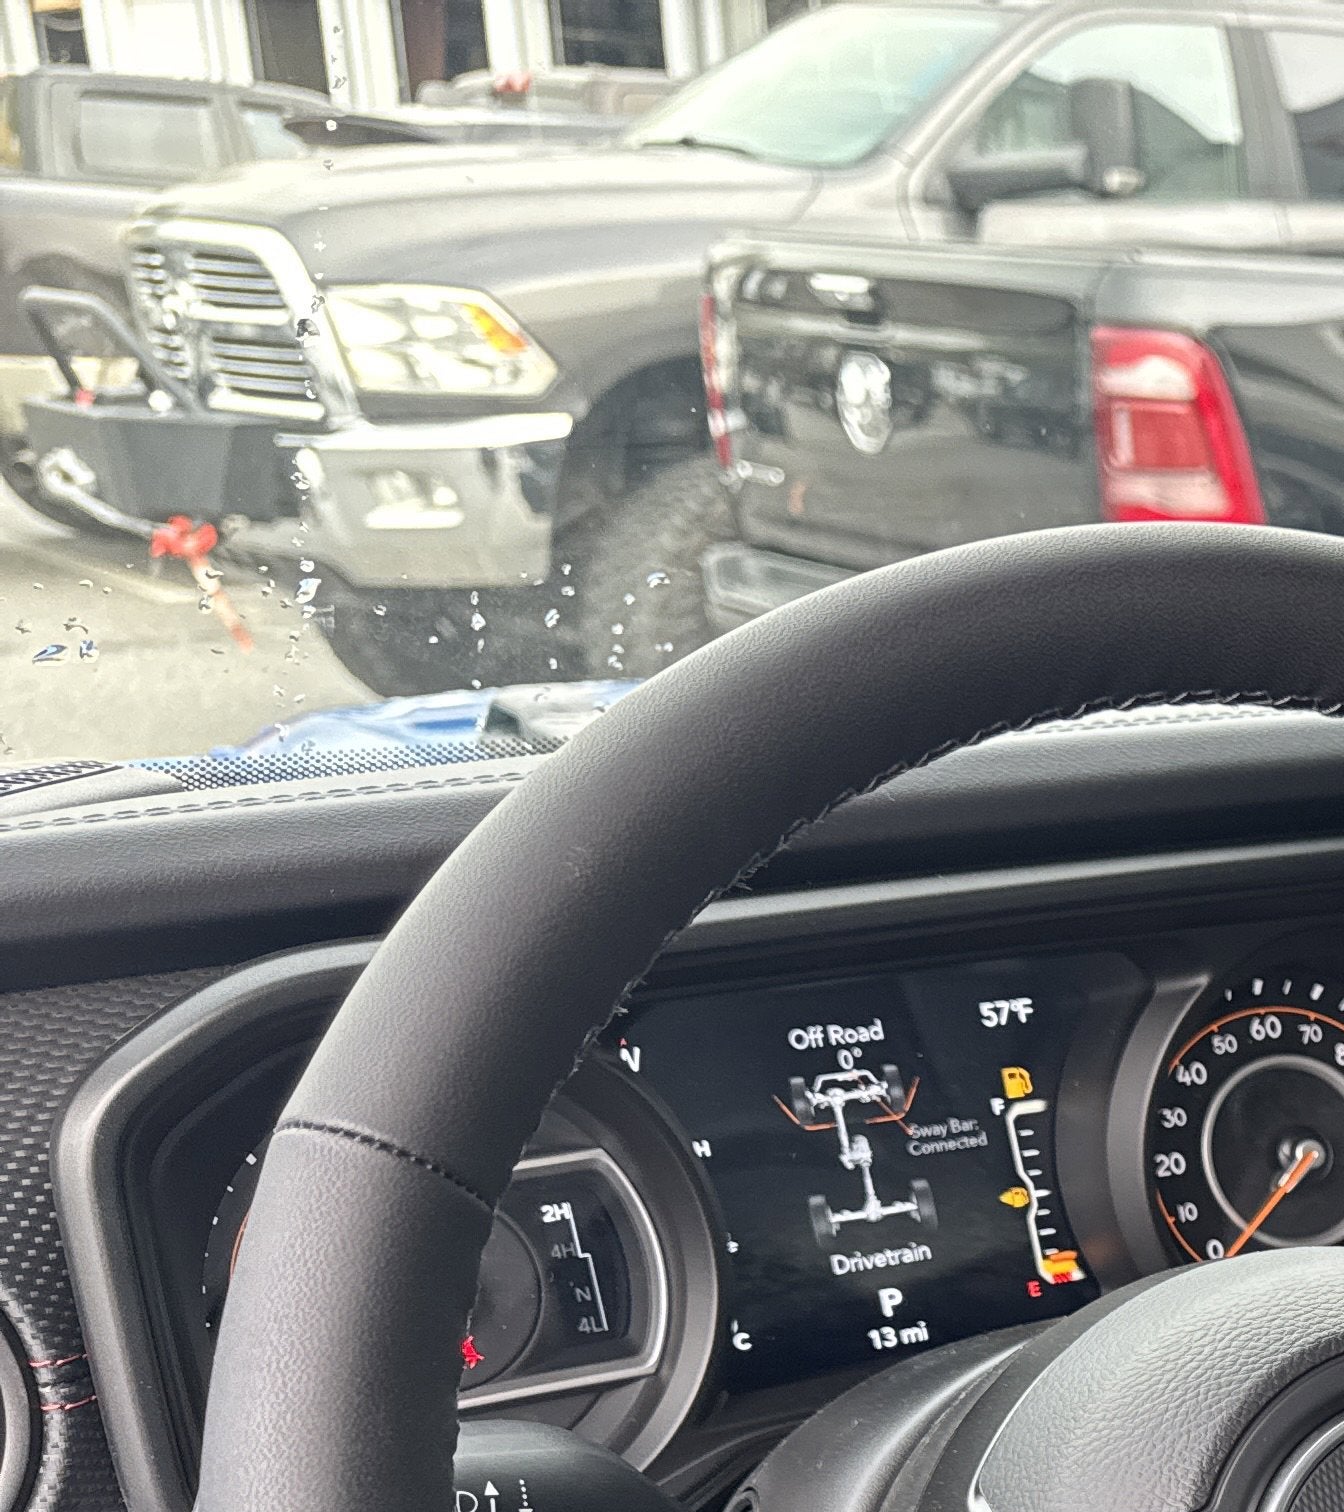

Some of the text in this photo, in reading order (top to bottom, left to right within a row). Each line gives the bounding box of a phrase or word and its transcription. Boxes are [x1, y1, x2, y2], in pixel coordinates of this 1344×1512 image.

[788, 1018, 885, 1050] Off Road
[1250, 1014, 1283, 1042] 60
[1298, 1022, 1324, 1045] 70
[1211, 1033, 1239, 1055] 50
[1176, 1061, 1208, 1087] 40
[911, 1119, 948, 1140] Sway
[1157, 1106, 1188, 1129] 30
[906, 1131, 989, 1157] Connected
[1153, 1151, 1187, 1178] 20
[540, 1202, 570, 1224] 2H
[1176, 1202, 1199, 1224] 10
[830, 1242, 933, 1276] Drivetrain
[878, 1287, 904, 1318] P
[867, 1320, 930, 1350] 13 mi
